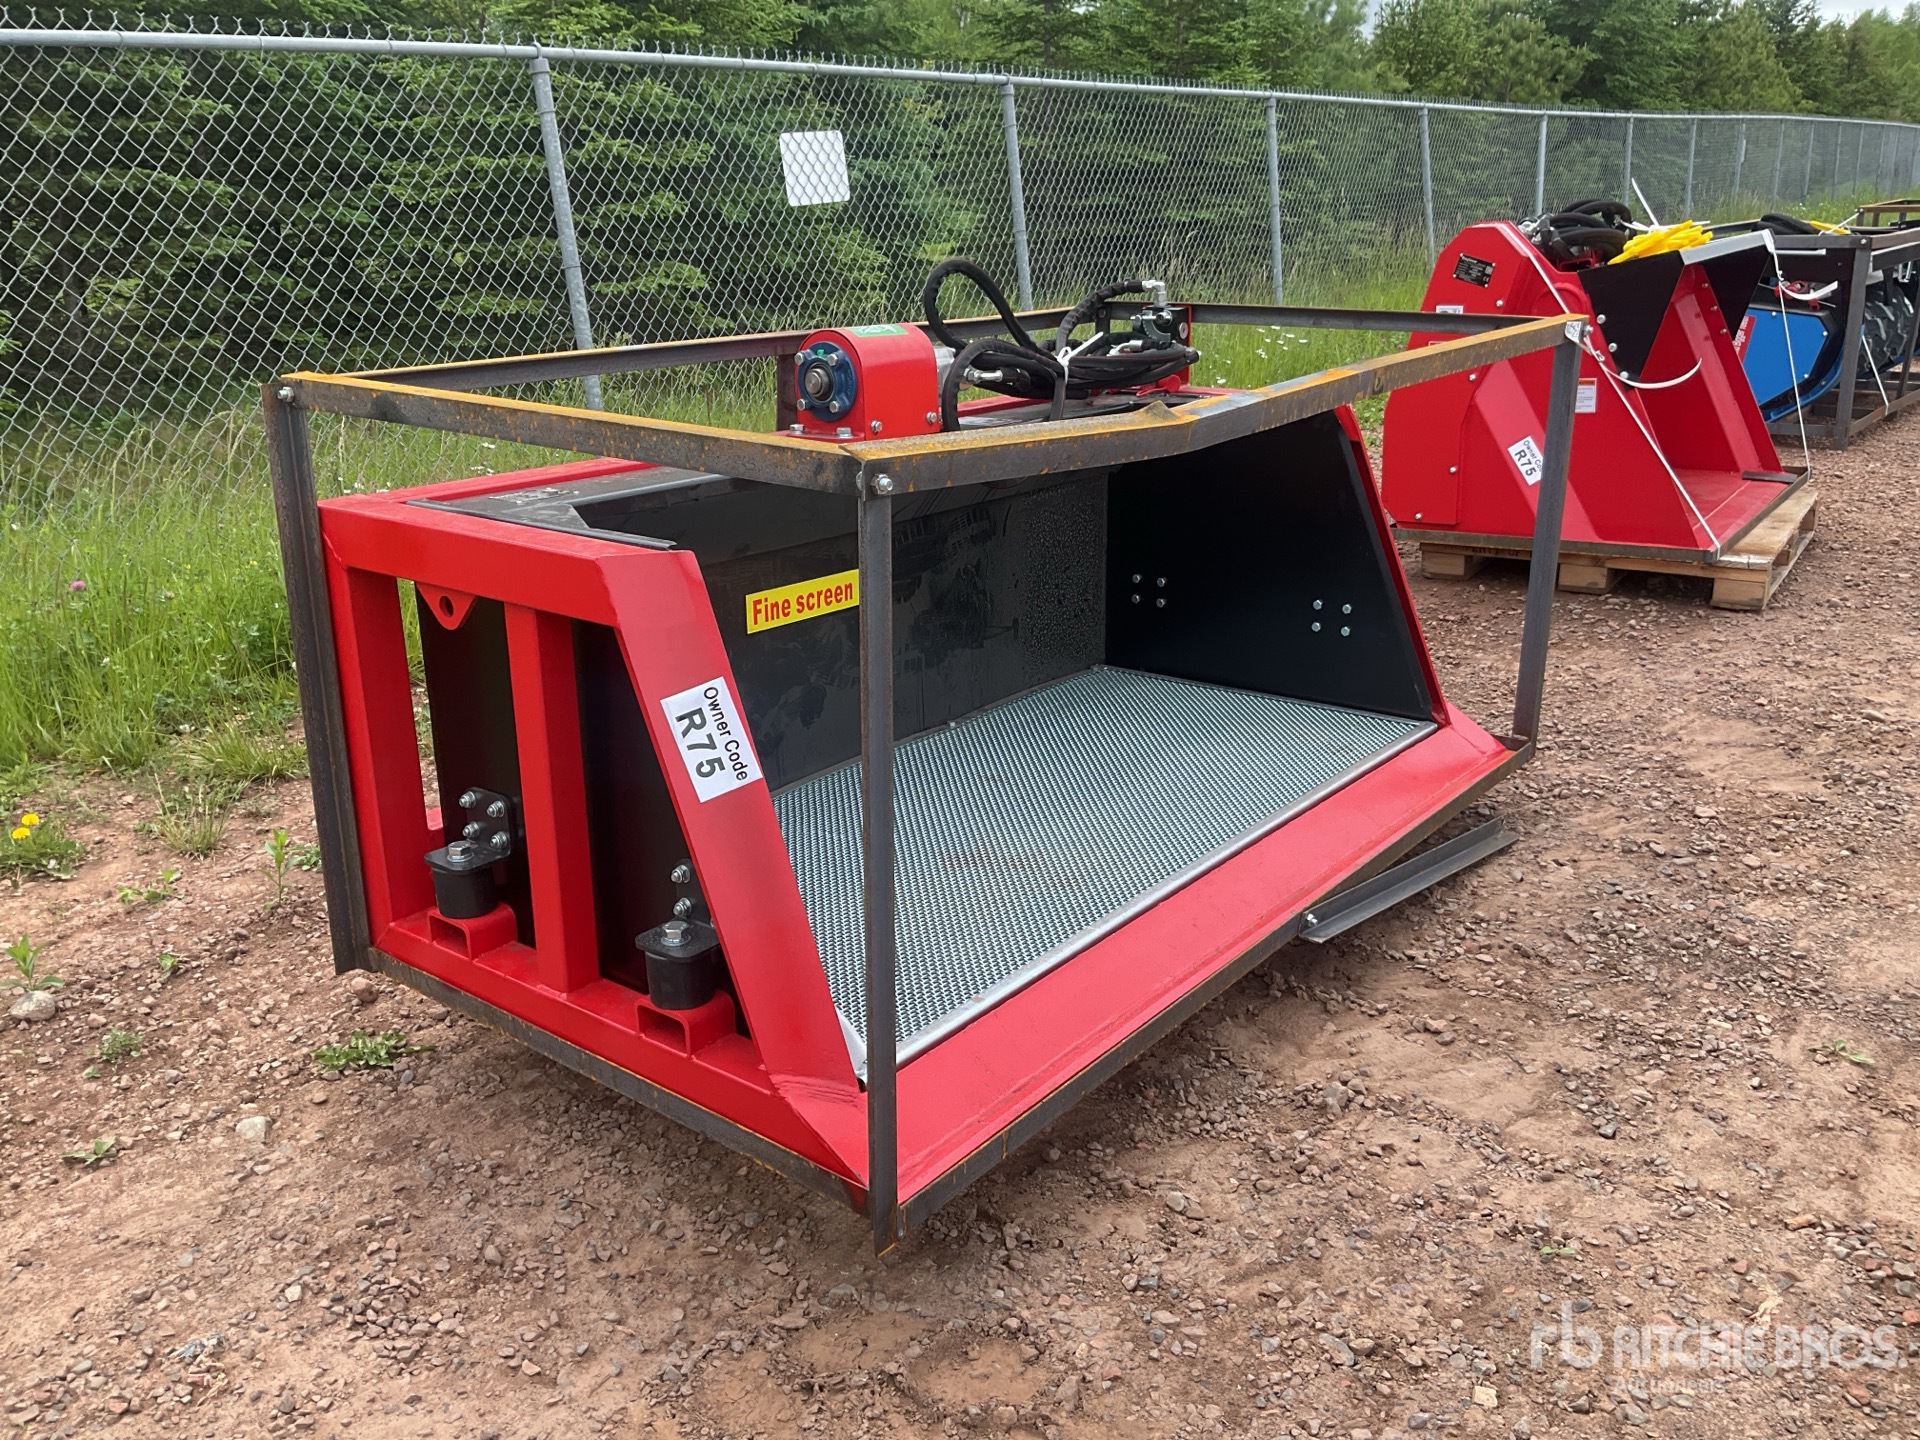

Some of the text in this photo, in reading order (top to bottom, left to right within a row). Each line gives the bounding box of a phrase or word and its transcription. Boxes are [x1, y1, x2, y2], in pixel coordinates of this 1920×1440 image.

[1514, 449, 1537, 477] R75
[1523, 440, 1543, 472] Owner Co
[752, 582, 853, 626] Fine screen
[674, 707, 725, 779] R75
[703, 686, 749, 781] Owner Code
